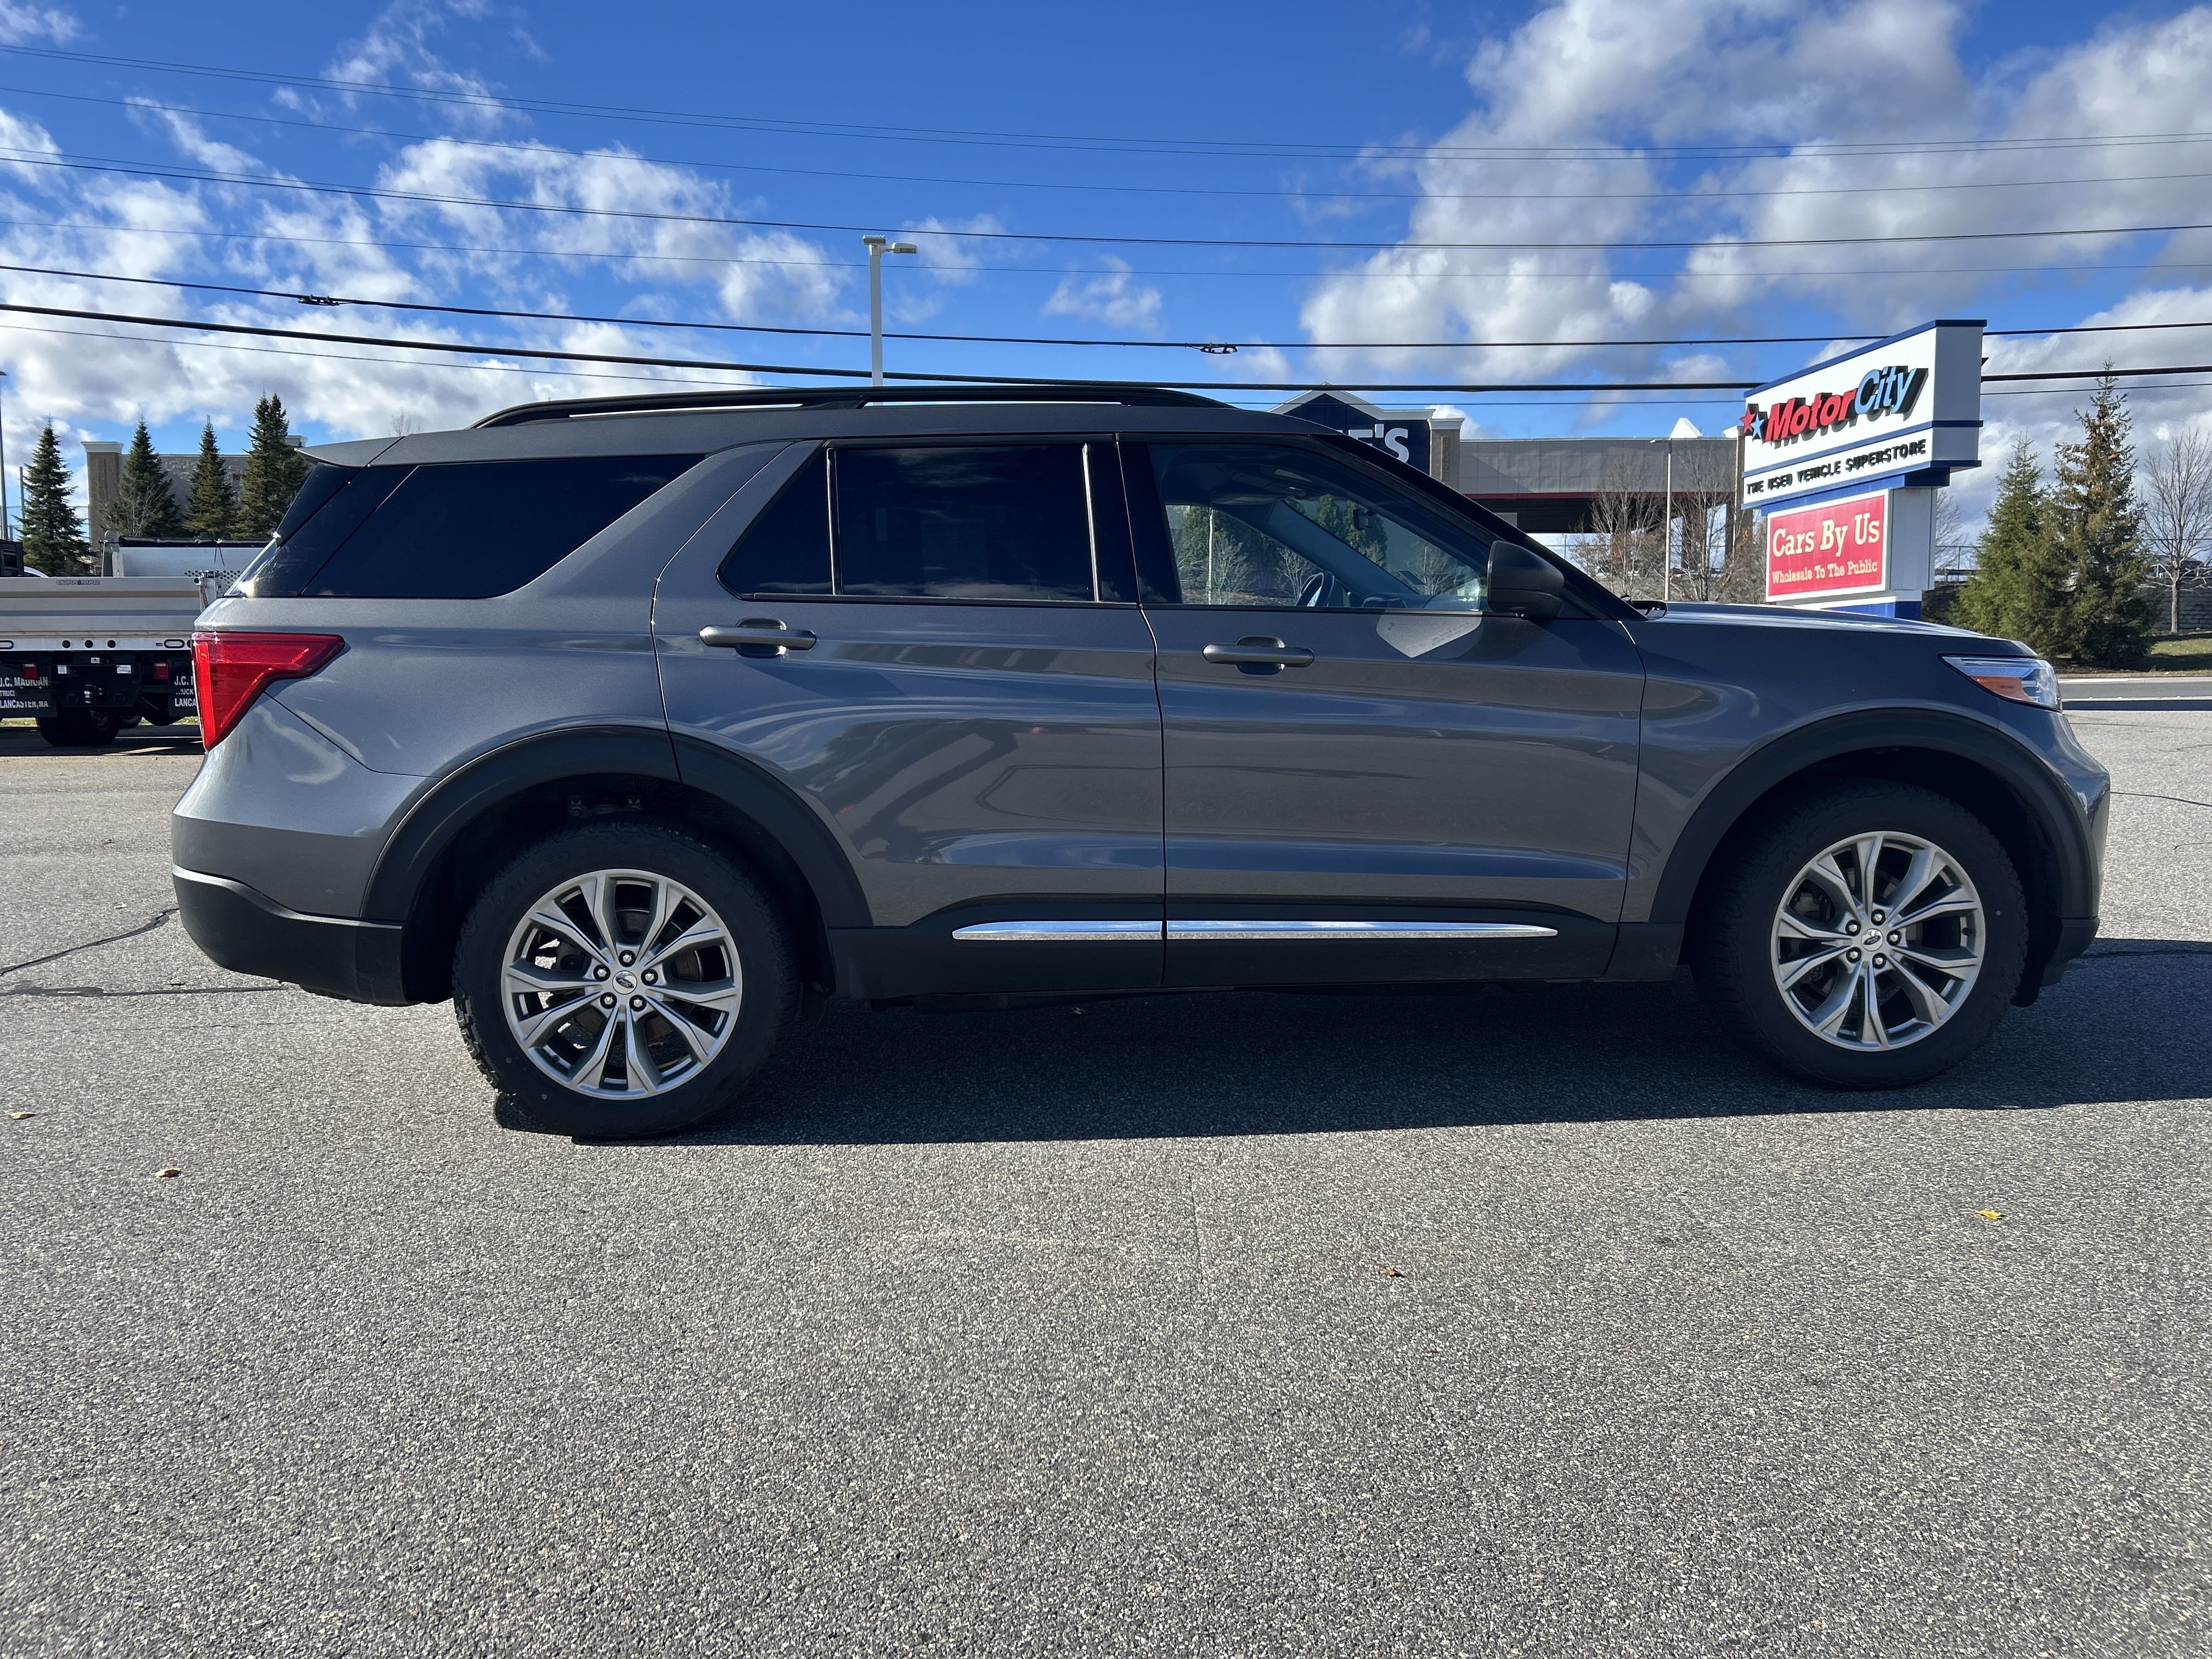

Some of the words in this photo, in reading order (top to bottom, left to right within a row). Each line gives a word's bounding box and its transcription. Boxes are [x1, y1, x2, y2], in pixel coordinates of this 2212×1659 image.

[1746, 481, 1764, 495] THE
[1768, 473, 1793, 490] USED
[1797, 461, 1841, 483] VEHICLE
[1846, 439, 1926, 472] SUPERSTORE
[1773, 528, 1815, 557] Cars
[1820, 520, 1848, 557] By
[1854, 512, 1880, 545] Us
[1772, 567, 1813, 584] Wholesale
[1814, 565, 1826, 579] To
[1827, 563, 1845, 578] The
[1847, 558, 1878, 575] Public
